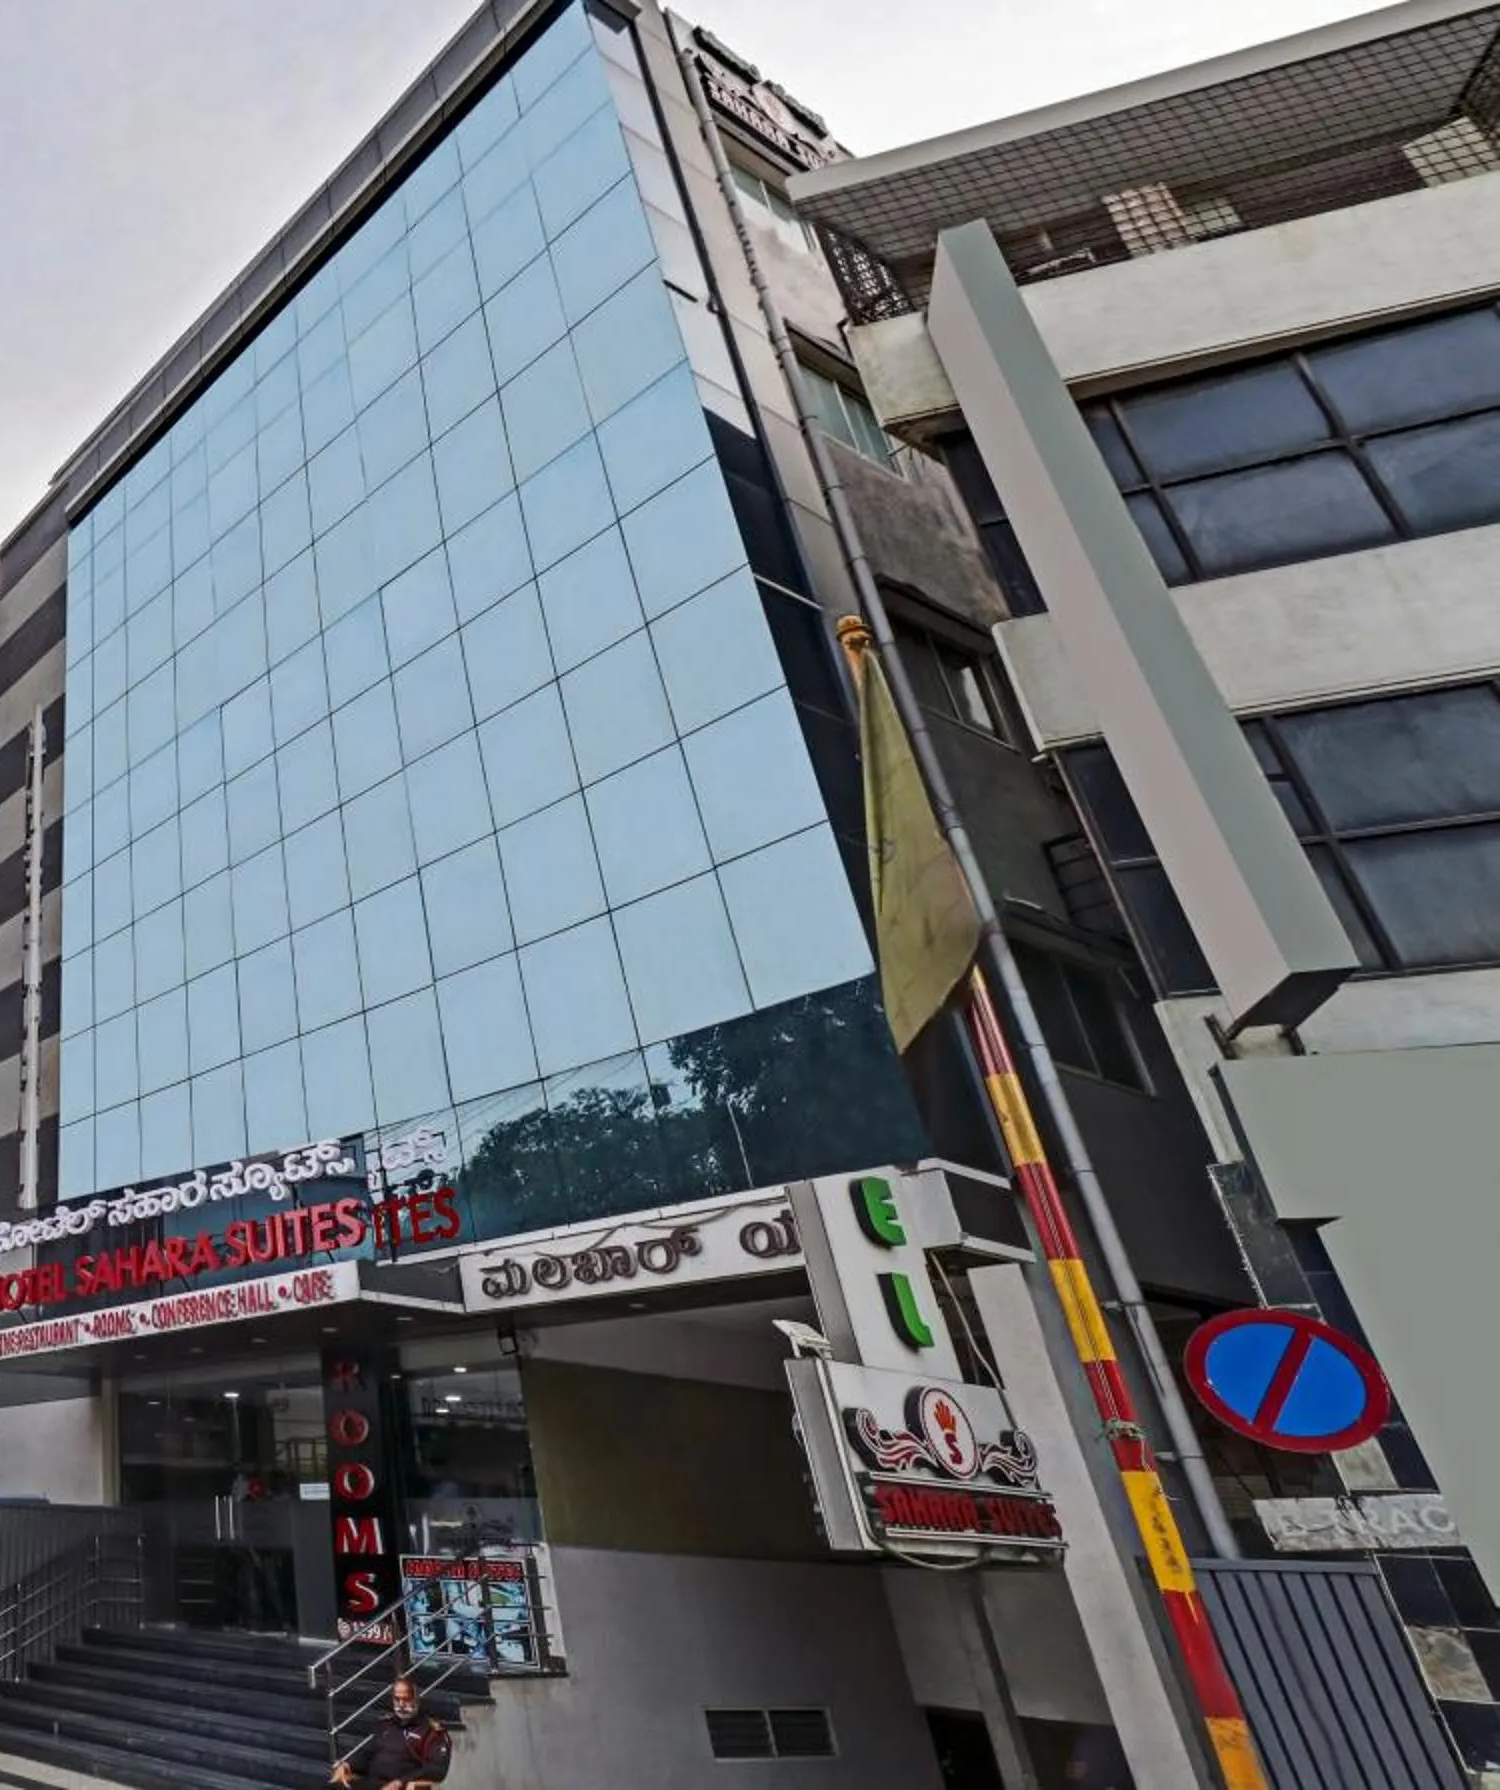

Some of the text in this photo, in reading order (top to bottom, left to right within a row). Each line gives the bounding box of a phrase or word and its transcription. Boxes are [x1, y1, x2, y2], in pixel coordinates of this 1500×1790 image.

[74, 1228, 222, 1297] SAHARA
[223, 1196, 367, 1268] SUITES
[92, 1310, 135, 1338] ROOMS
[151, 1290, 236, 1329] CONFERENCE
[237, 1282, 276, 1315] HALL
[291, 1271, 334, 1305] CAFE
[326, 1356, 384, 1614] ROOMS
